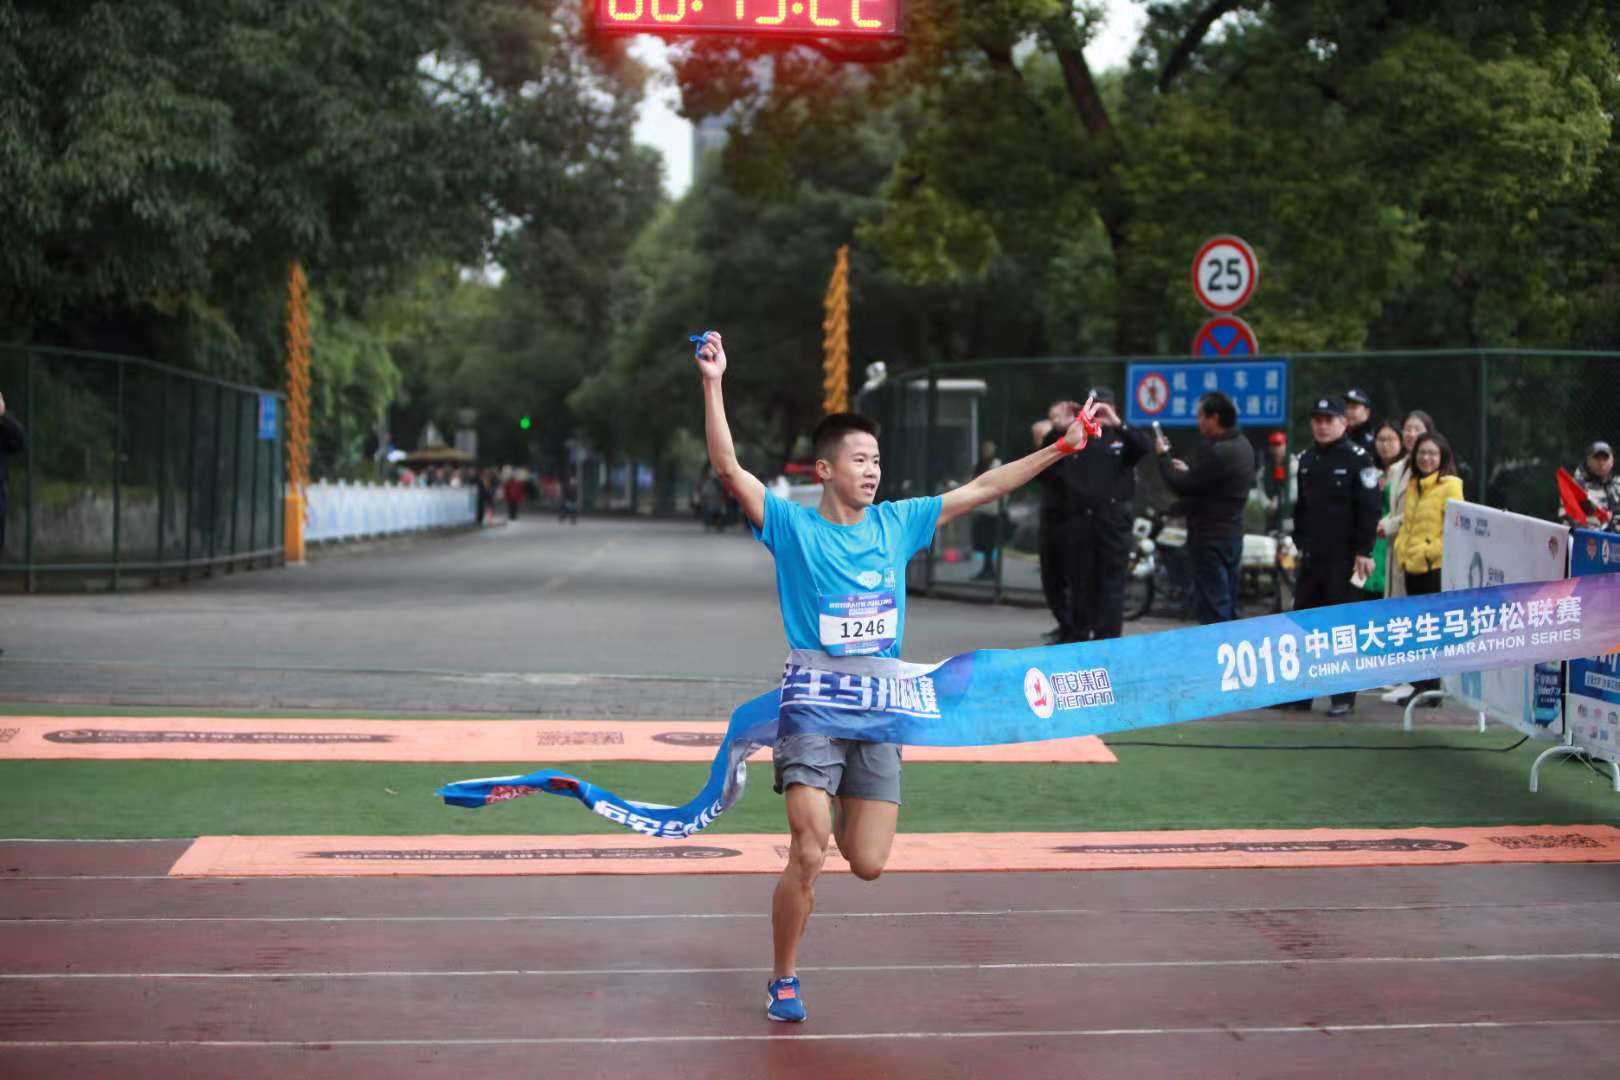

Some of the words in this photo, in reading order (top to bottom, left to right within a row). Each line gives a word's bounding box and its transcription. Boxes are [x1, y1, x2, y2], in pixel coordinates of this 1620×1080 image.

[1207, 258, 1242, 291] 25
[840, 618, 885, 639] 1246
[1217, 634, 1300, 692] 2018
[1305, 596, 1582, 659] 中国大学生马拉松联赛
[1309, 660, 1351, 678] CHINA
[1355, 646, 1440, 671] UNIVERSITY
[1444, 636, 1526, 657] MARATHON
[1531, 628, 1582, 646] SERIES
[1050, 668, 1110, 694] 恒安集团
